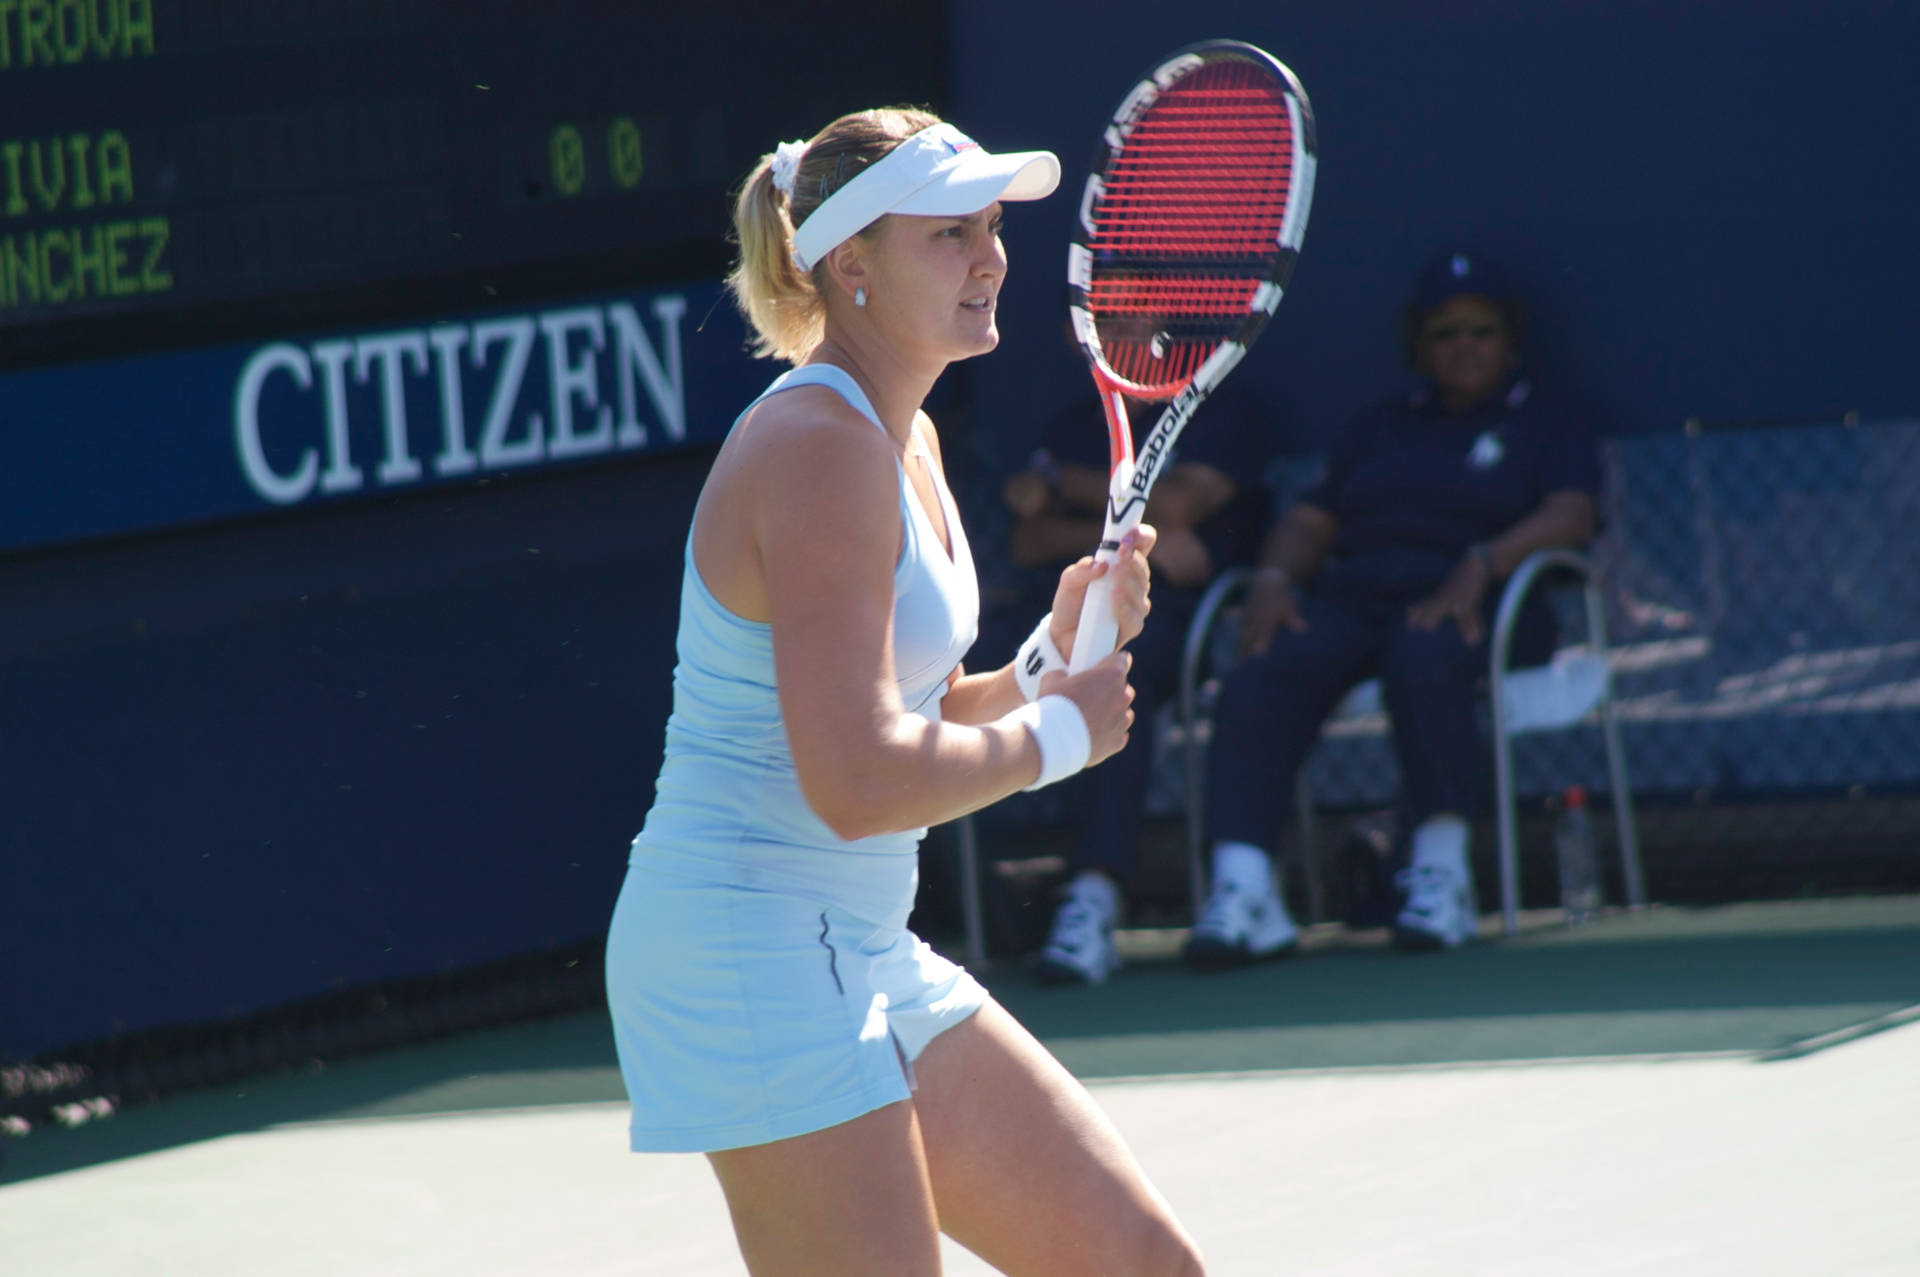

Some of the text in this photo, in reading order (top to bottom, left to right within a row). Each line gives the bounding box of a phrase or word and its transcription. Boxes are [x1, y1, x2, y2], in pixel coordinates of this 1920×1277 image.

[551, 118, 642, 194] 0 0
[0, 217, 173, 305] NCHEZ
[235, 297, 685, 501] CITIZEN
